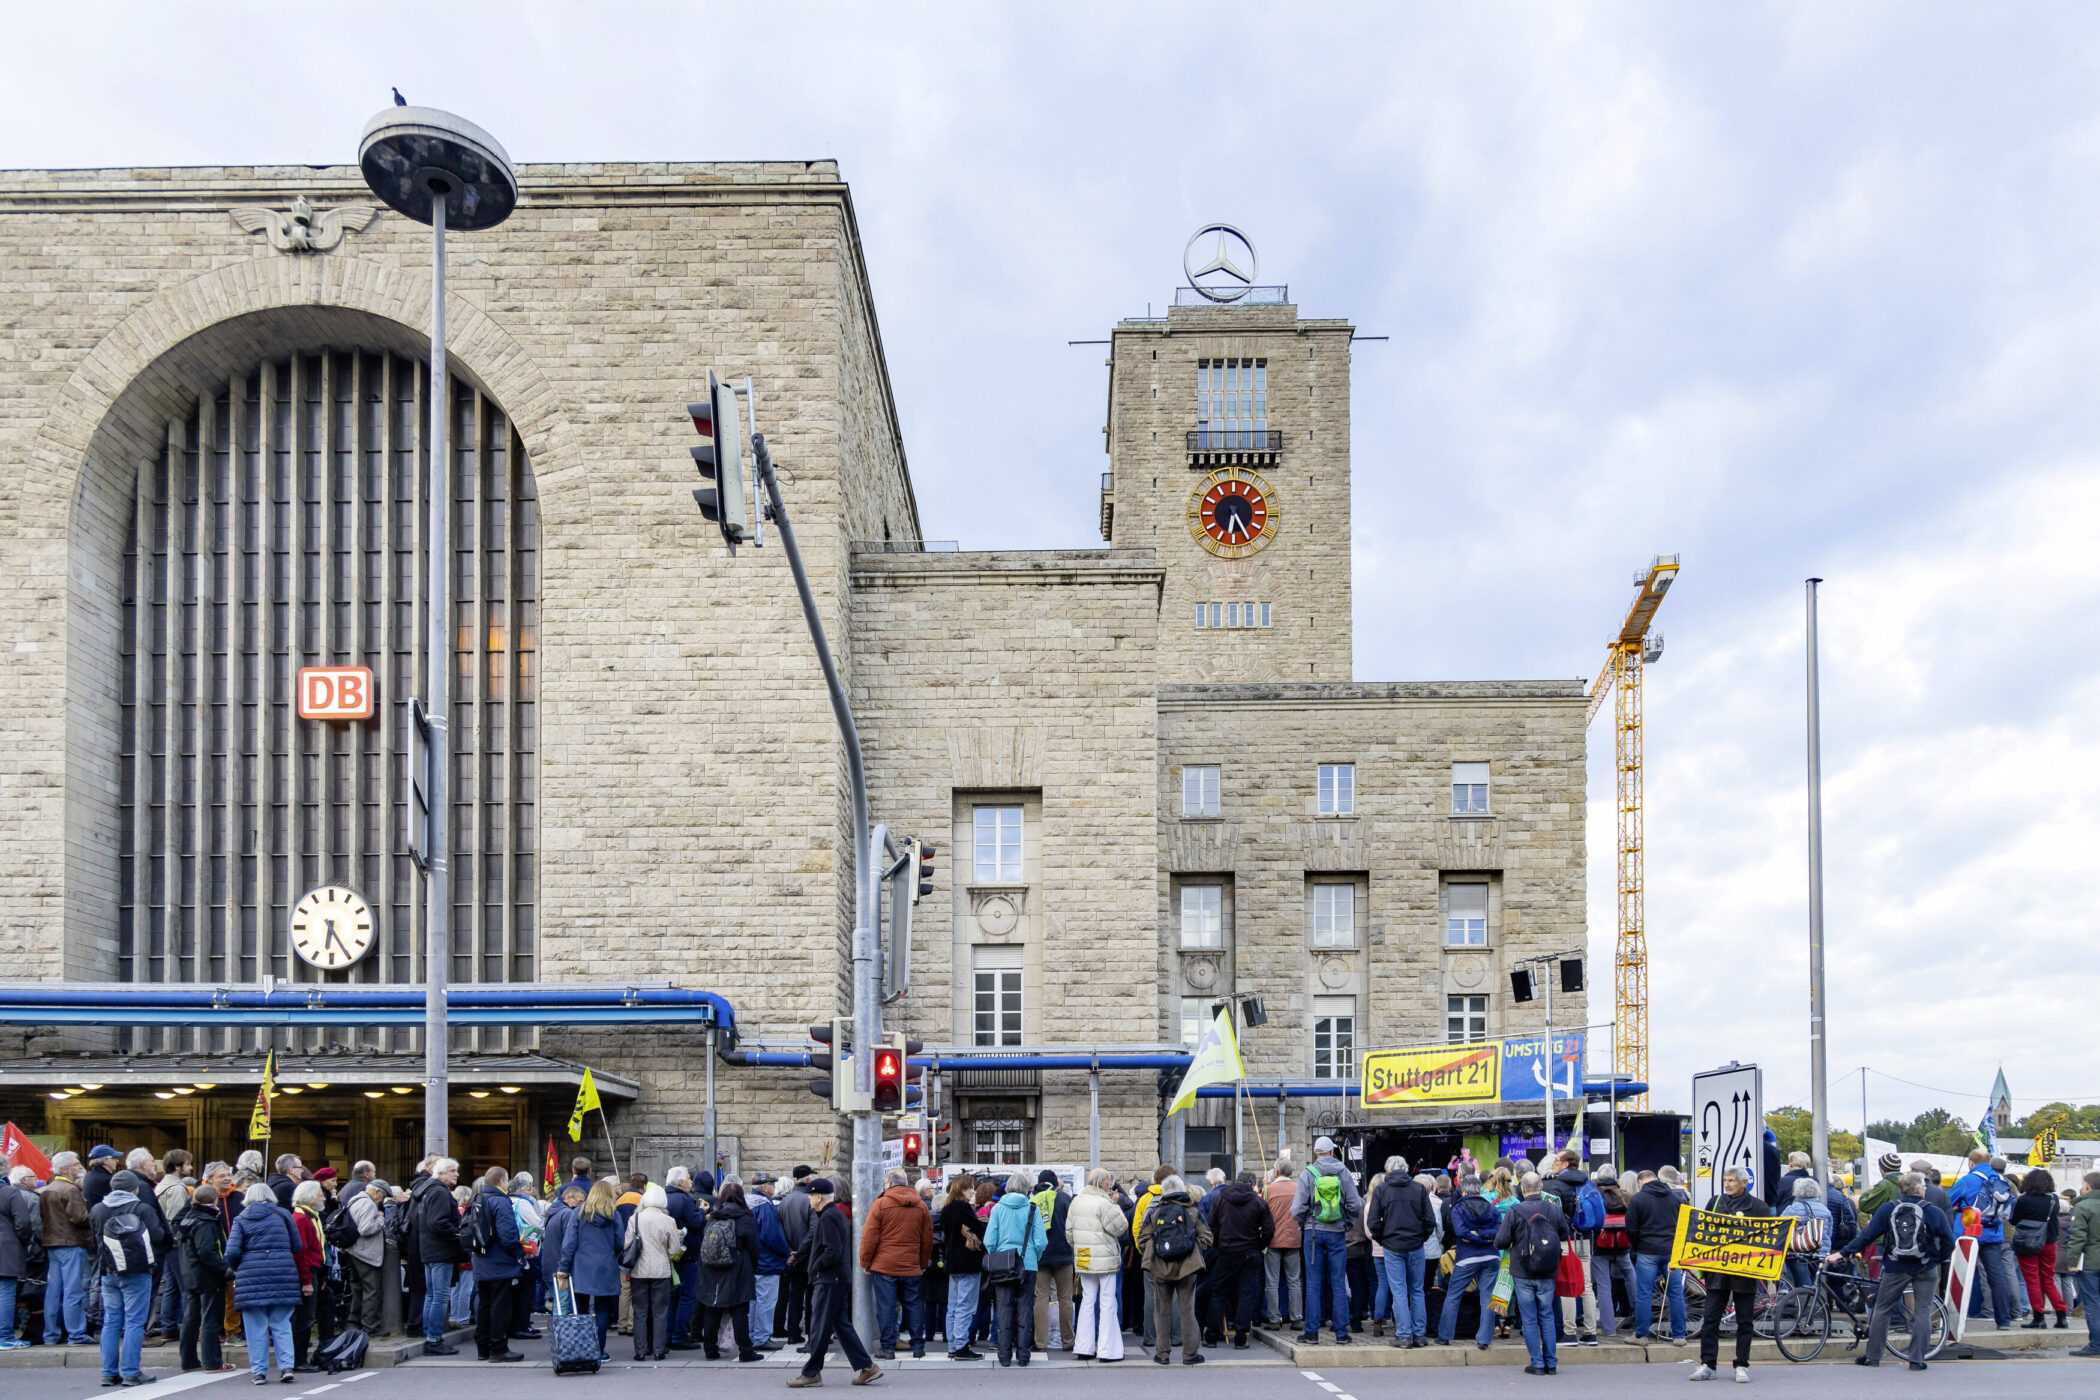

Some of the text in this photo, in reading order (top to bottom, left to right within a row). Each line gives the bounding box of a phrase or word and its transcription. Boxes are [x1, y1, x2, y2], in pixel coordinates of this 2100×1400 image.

[309, 676, 363, 709] DB
[1505, 1039, 1579, 1058] UMSTIG 21
[1373, 1060, 1488, 1093] Stuttgart 21
[1757, 1252, 1775, 1269] 21
